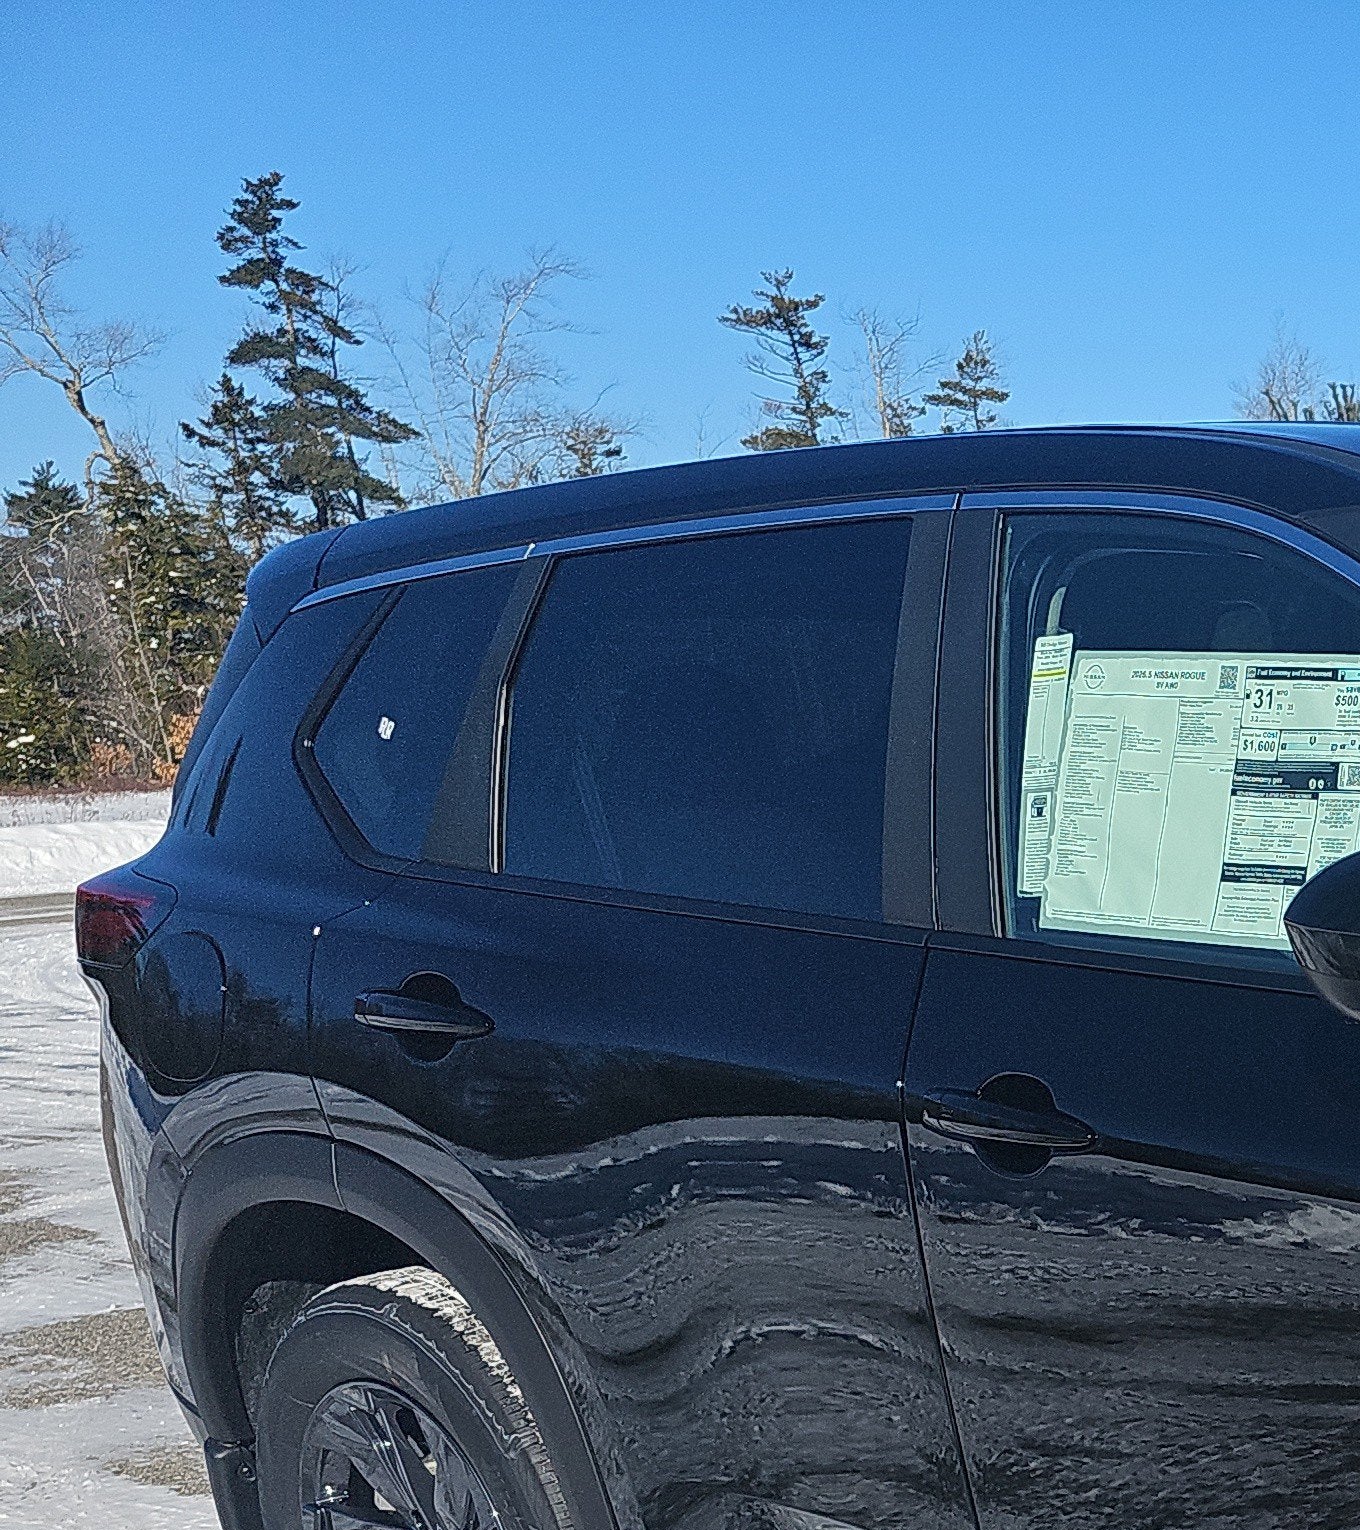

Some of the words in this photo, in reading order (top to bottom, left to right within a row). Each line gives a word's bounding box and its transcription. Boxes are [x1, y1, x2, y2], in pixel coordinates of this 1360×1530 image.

[1153, 670, 1180, 680] NISSAN
[1180, 671, 1207, 681] ROGUE
[1253, 688, 1273, 710] 31
[1334, 694, 1359, 707] $500
[1242, 738, 1276, 753] $1,600
